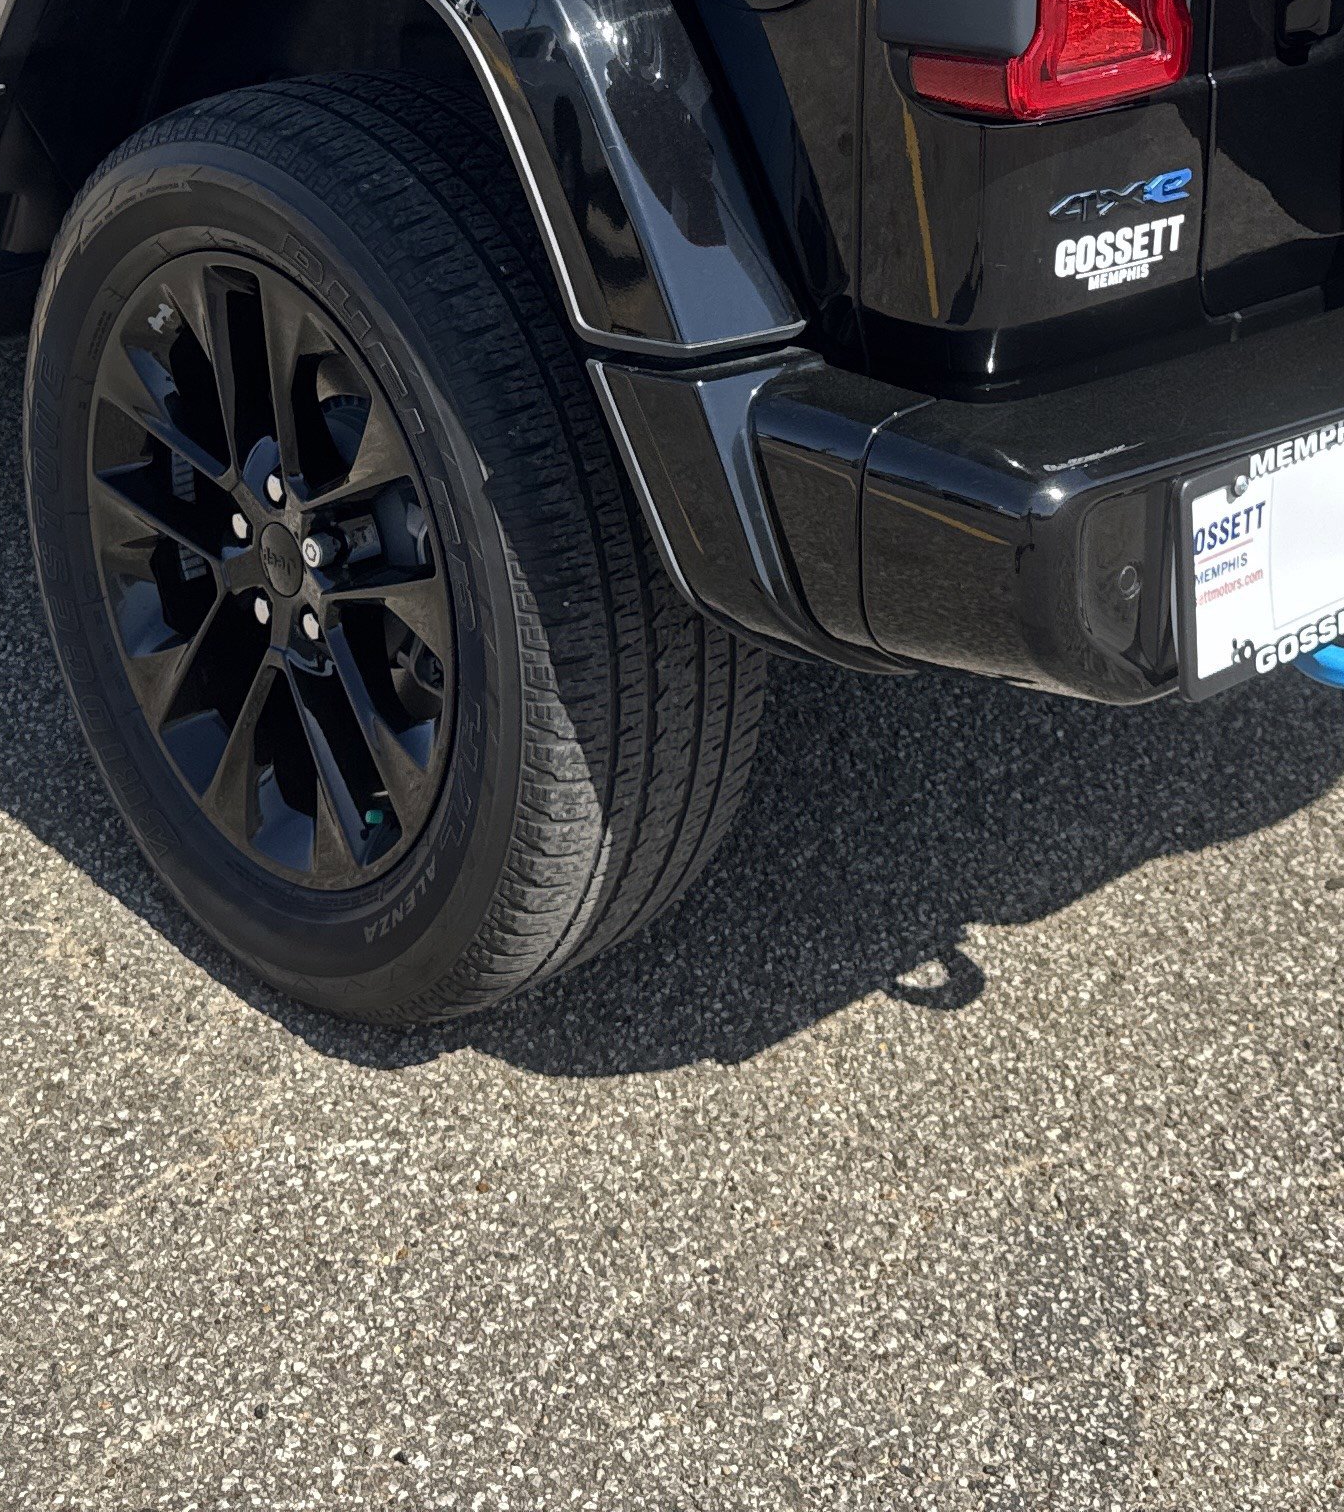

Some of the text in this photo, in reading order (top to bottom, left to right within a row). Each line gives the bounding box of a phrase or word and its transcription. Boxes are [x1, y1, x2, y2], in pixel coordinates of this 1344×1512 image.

[1054, 213, 1185, 278] GOSSETT
[1087, 263, 1150, 291] MEMPHIS
[1194, 500, 1266, 556] OSSETT
[1195, 552, 1248, 585] MEMPHIS
[1196, 568, 1264, 606] ettmotors.com
[31, 352, 182, 857] BRIDGESTONE
[363, 854, 436, 945] ALENZA
